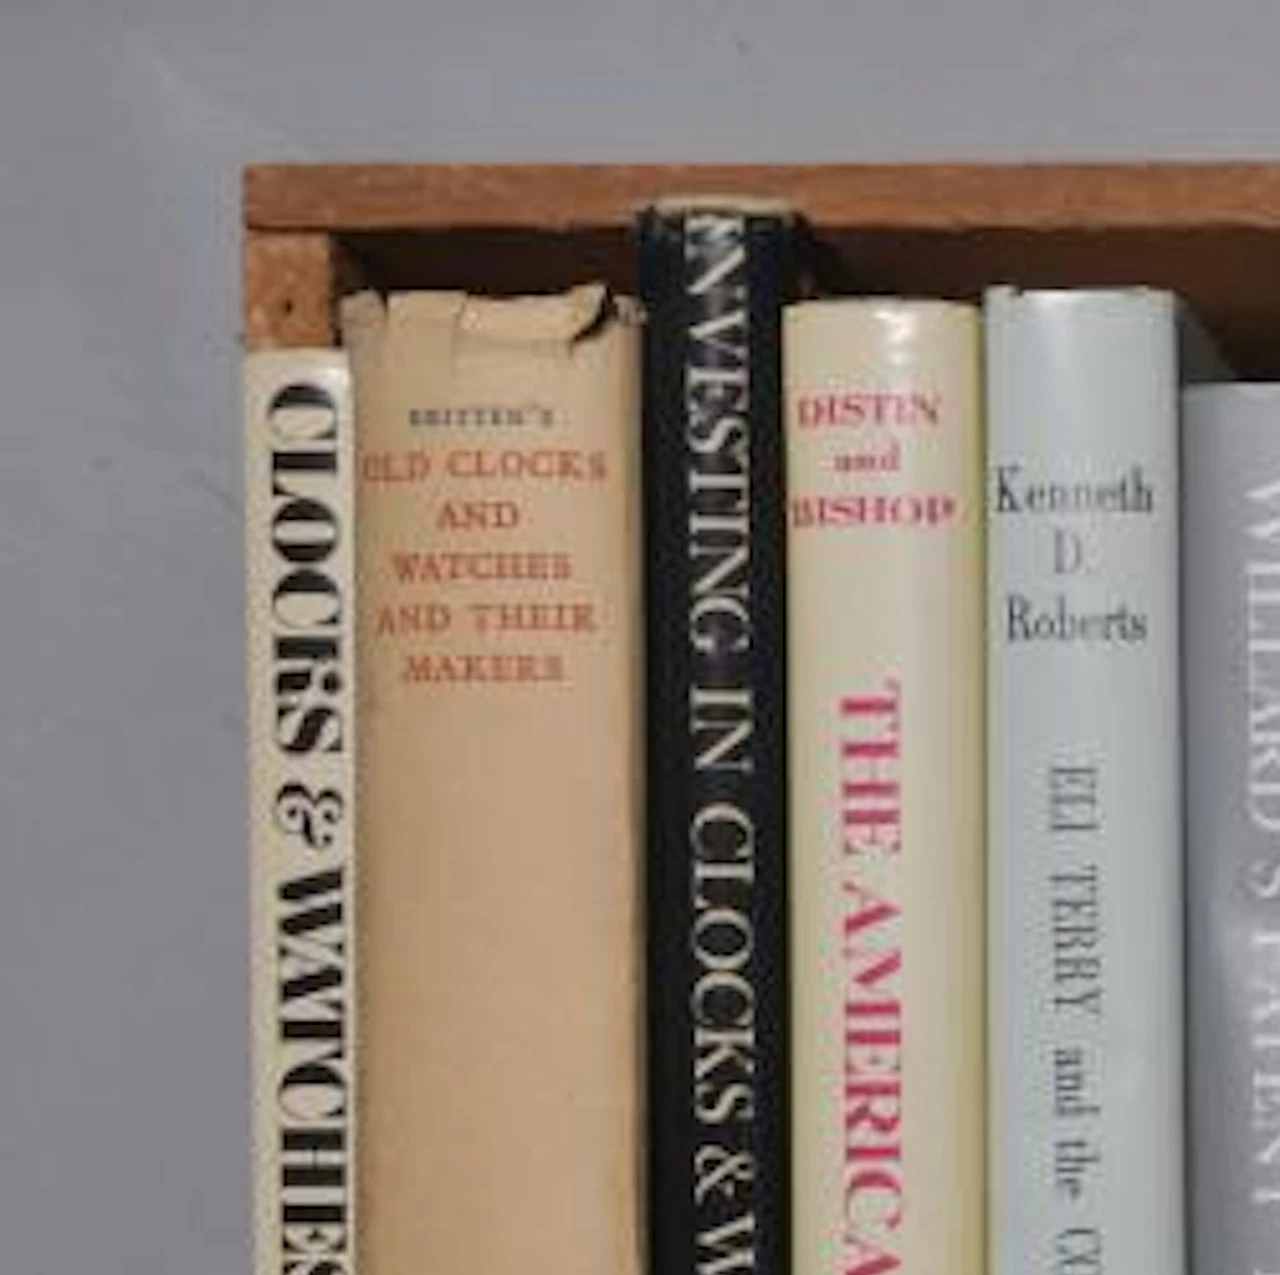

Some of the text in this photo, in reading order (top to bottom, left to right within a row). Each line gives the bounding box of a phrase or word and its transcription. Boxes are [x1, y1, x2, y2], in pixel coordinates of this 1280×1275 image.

[685, 213, 754, 654] INVESTING
[797, 392, 943, 427] DISTIN
[447, 450, 608, 480] CLOCKS
[835, 447, 901, 473] and
[994, 464, 1155, 515] Kenneth
[436, 501, 520, 529] AND
[792, 495, 956, 528] BISHOP
[268, 383, 343, 757] CLOCKS
[391, 553, 572, 580] WATCHES
[377, 603, 598, 636] AND THEIR
[1006, 594, 1148, 643] Roberts
[405, 656, 566, 682] MAKERS
[689, 686, 754, 773] IN
[840, 683, 901, 857] THE
[1048, 766, 1099, 833] ELI
[275, 782, 344, 849] &
[690, 803, 756, 1125] CLOCKS
[1050, 864, 1101, 1015] TERRY
[1054, 1046, 1101, 1118] and
[692, 1145, 756, 1206] &
[1055, 1138, 1102, 1200] the
